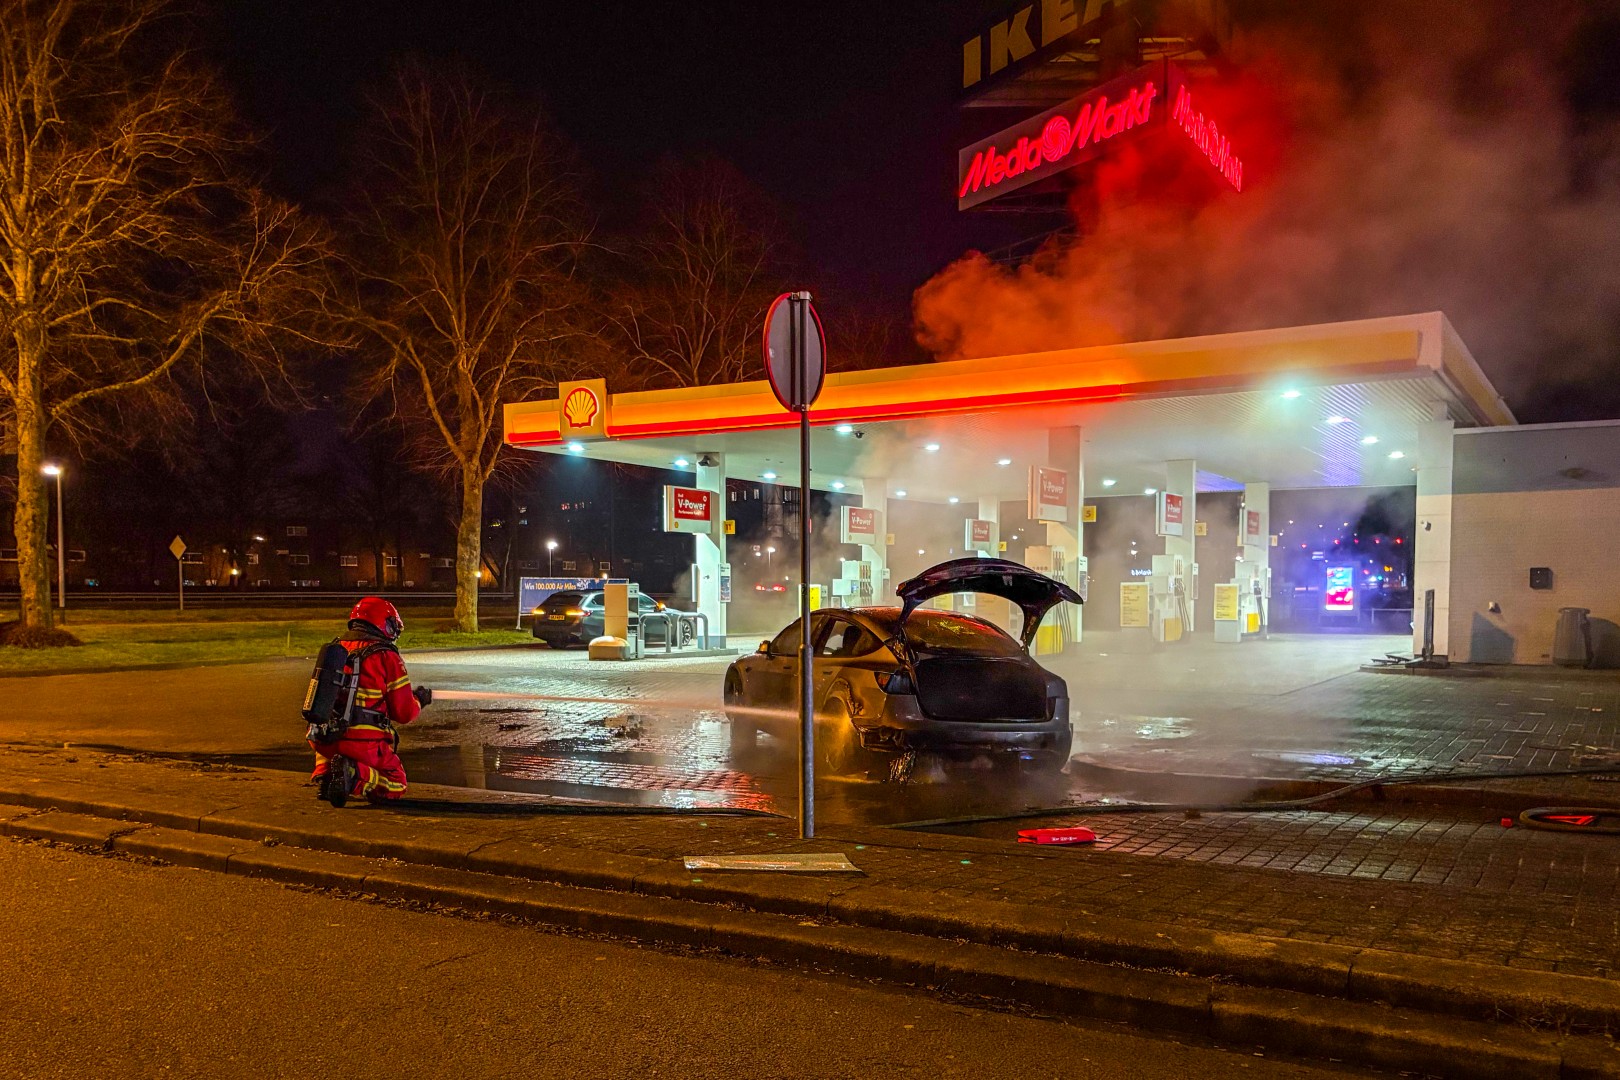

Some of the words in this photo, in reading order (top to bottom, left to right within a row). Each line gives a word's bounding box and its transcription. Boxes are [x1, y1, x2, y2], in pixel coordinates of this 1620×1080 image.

[1042, 480, 1064, 494] V-Power
[677, 498, 706, 511] V-Power
[1085, 510, 1092, 518] 5
[851, 516, 872, 526] V-Power
[524, 582, 535, 590] Win
[535, 582, 556, 590] 100.000
[556, 582, 564, 590] Air
[564, 582, 577, 590] Miles
